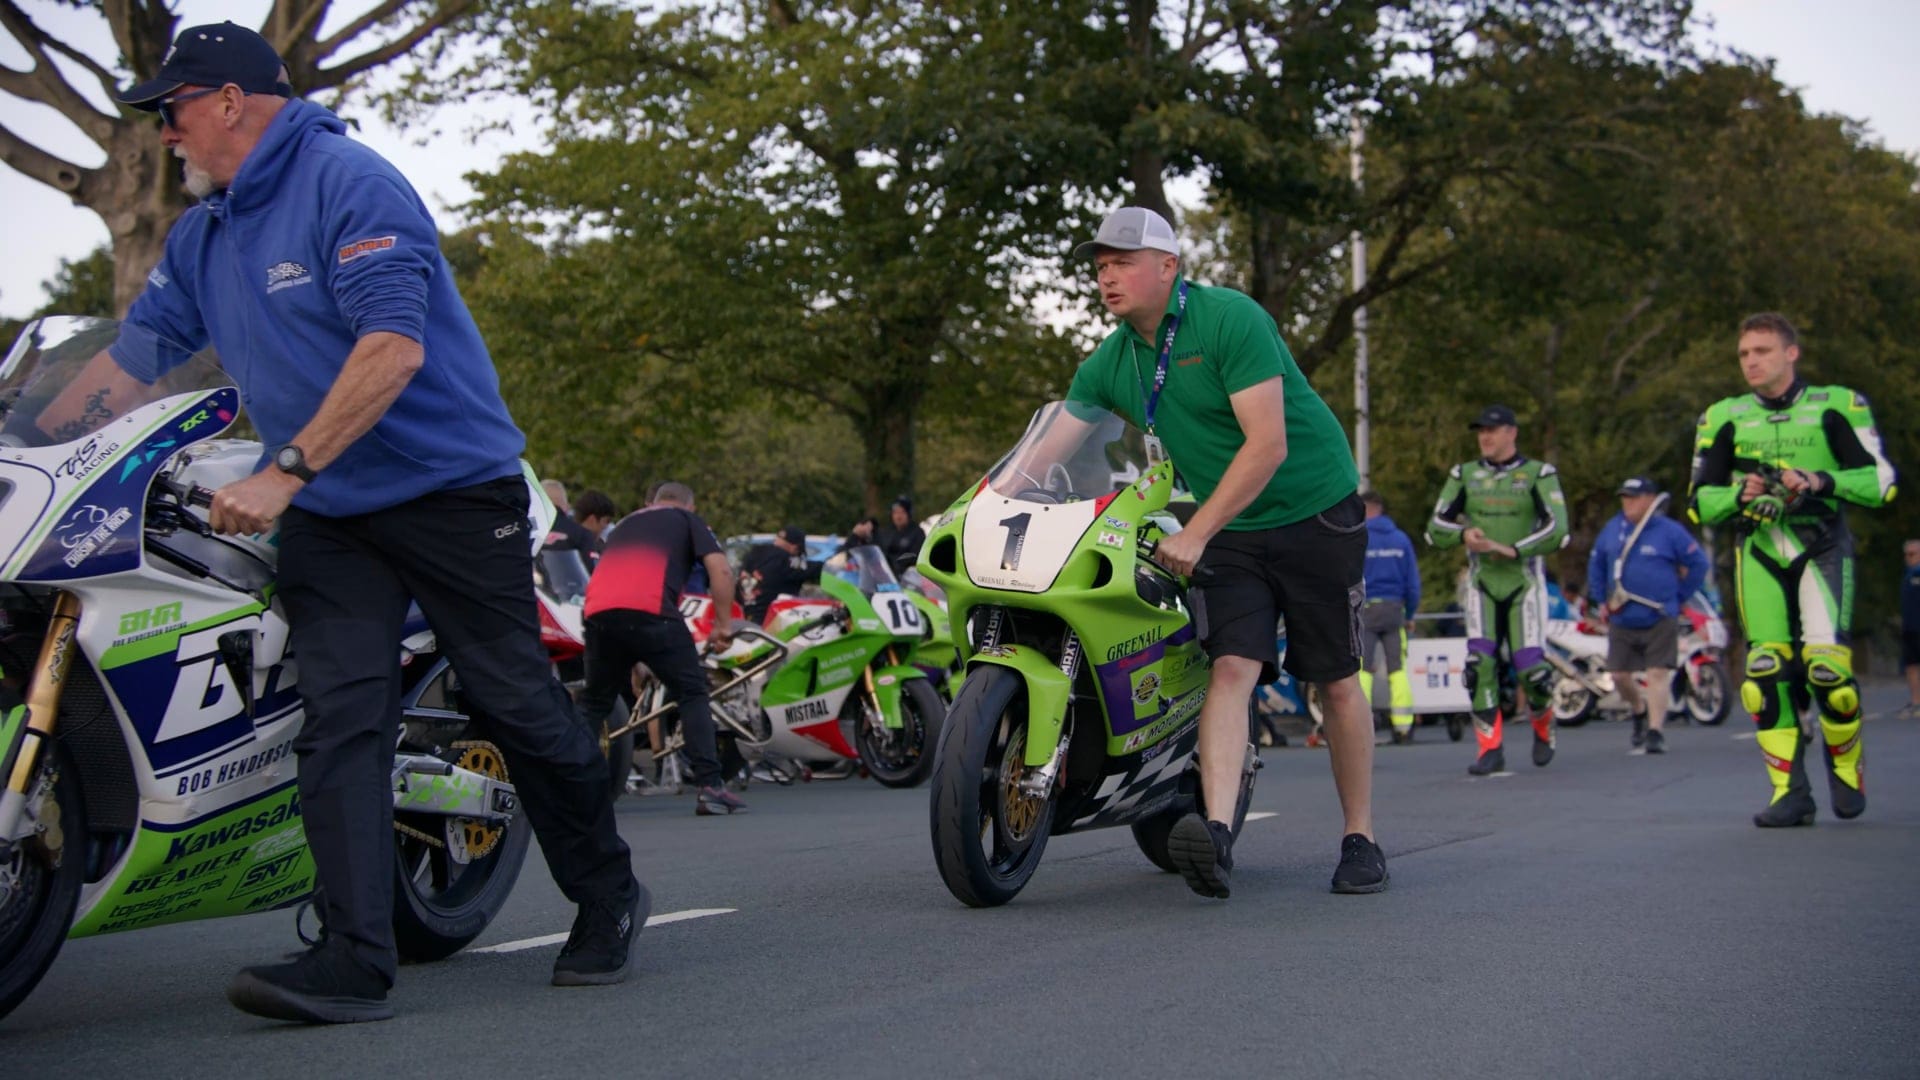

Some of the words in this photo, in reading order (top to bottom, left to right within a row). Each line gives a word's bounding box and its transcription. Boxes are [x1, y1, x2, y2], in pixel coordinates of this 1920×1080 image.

[74, 442, 120, 480] RACING
[999, 512, 1032, 571] 1
[977, 575, 1006, 586] GREENALL
[887, 599, 919, 629] 10
[1107, 625, 1163, 661] GREENALL
[785, 699, 829, 724] MISTRAL
[176, 769, 212, 796] BOB
[163, 792, 302, 864] Kawasak
[123, 847, 250, 895] READER
[240, 851, 300, 888] SNT
[109, 874, 229, 918] topsigns.net
[244, 876, 310, 910] MOTUL
[98, 898, 202, 932] METZELER
